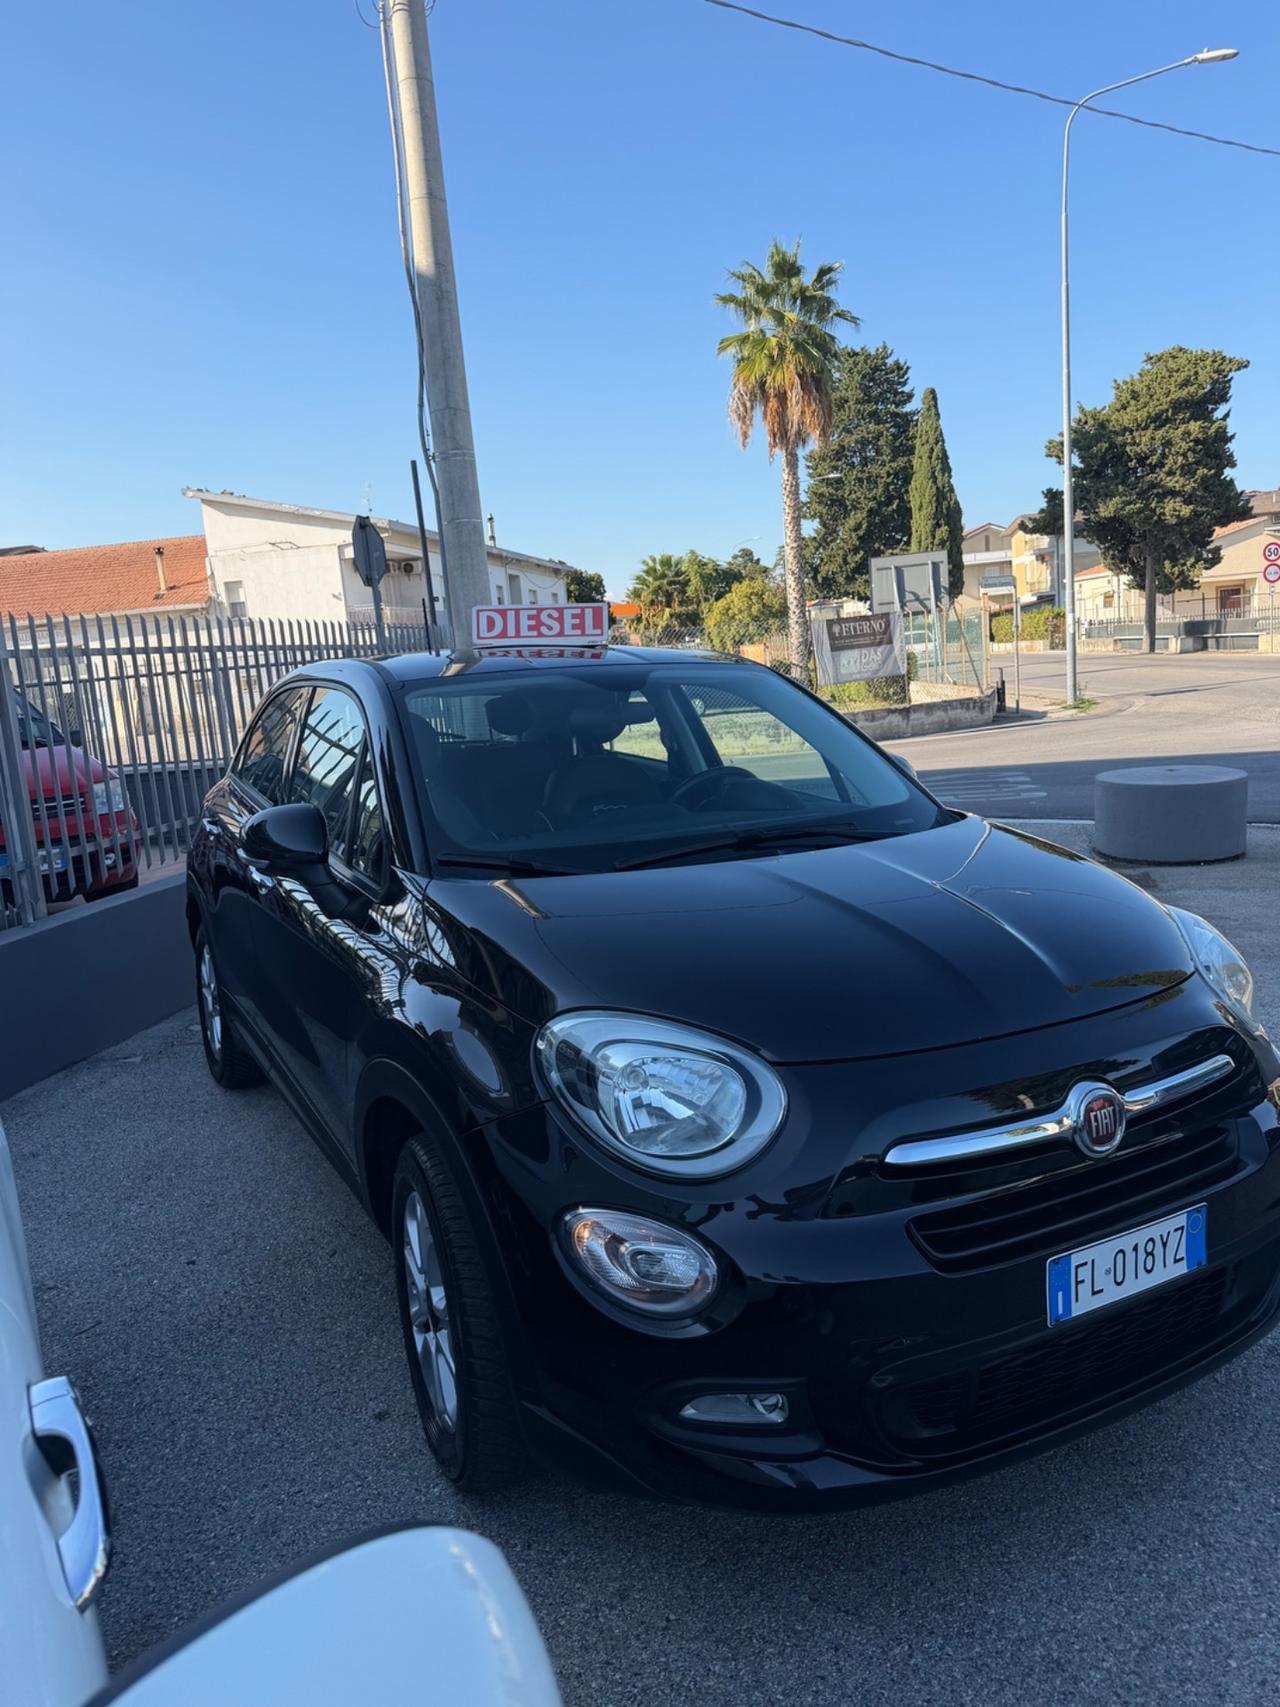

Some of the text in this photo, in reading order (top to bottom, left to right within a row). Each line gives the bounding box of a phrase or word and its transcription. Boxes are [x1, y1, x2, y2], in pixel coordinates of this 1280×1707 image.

[1267, 547, 1279, 557] 50
[478, 608, 602, 638] DIESEL
[842, 619, 886, 637] ETERNO
[1090, 1106, 1115, 1138] FIAT
